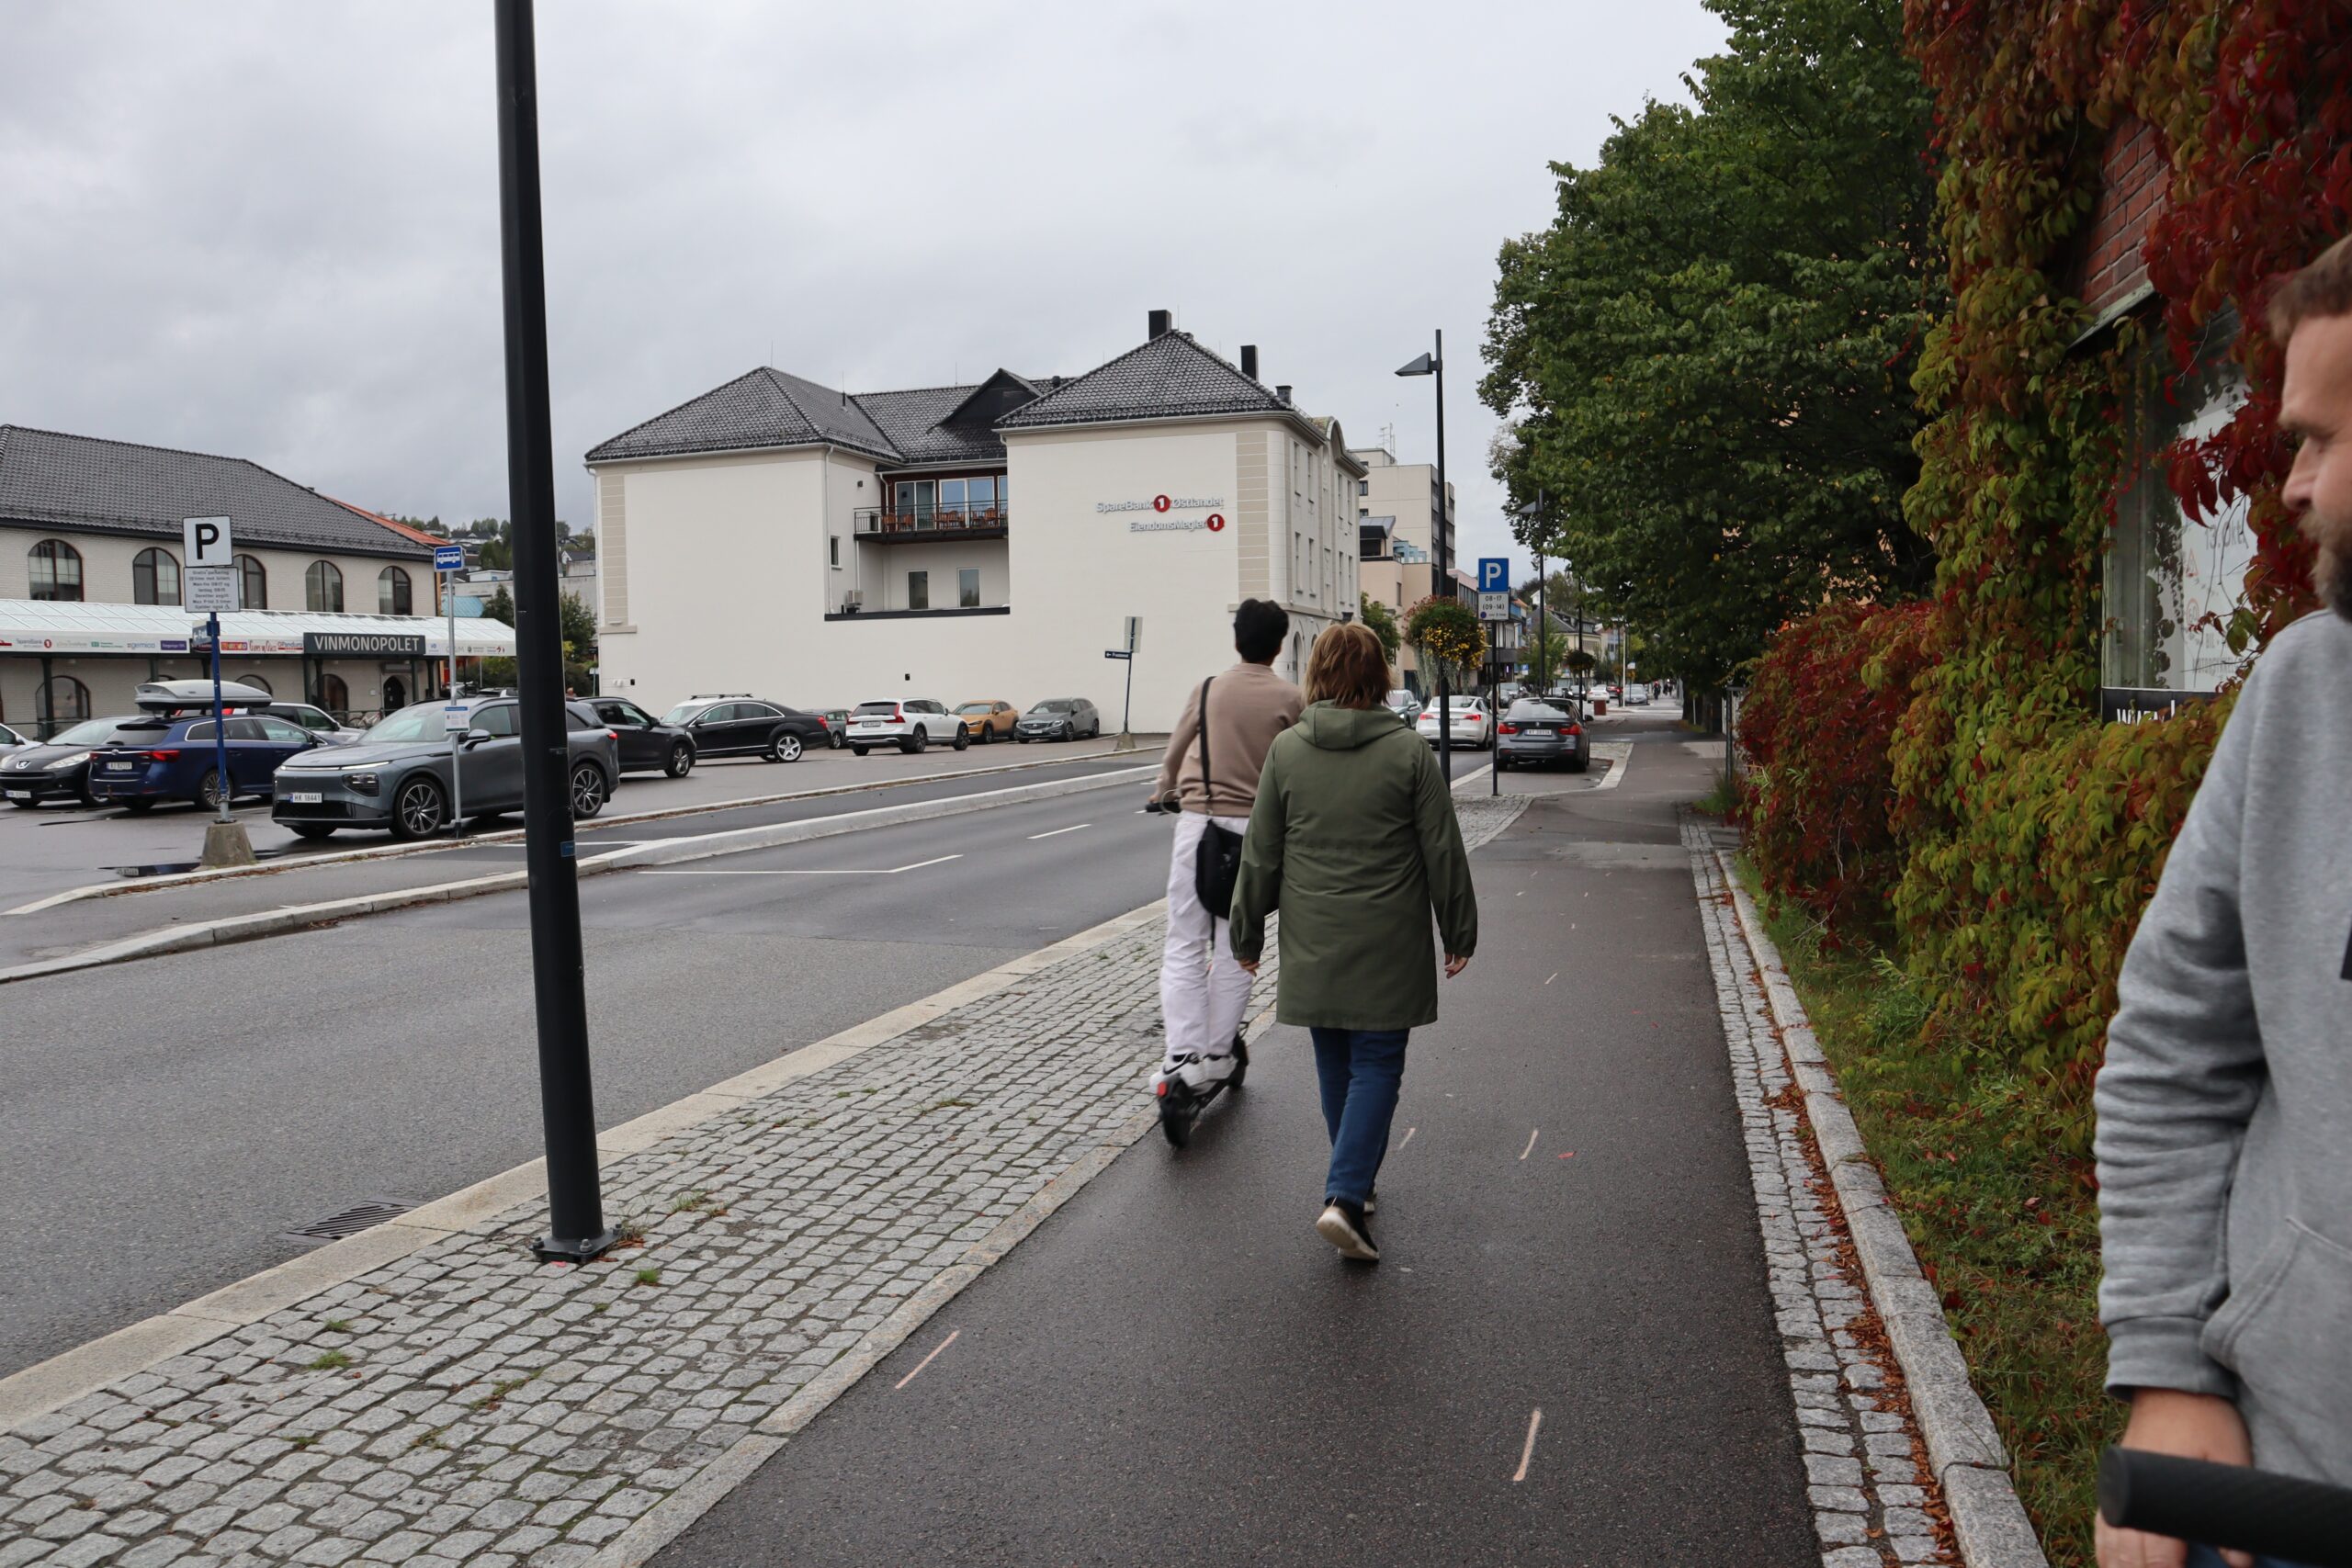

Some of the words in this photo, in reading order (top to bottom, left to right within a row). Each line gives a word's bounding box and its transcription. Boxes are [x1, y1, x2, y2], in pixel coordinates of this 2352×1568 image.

[1096, 501, 1153, 513] SpareBank
[1171, 497, 1225, 509] Østlandet
[1130, 520, 1206, 532] EiendomsMegler
[195, 523, 219, 559] P
[1486, 562, 1502, 588] P
[314, 636, 420, 651] VINMONOPOLET
